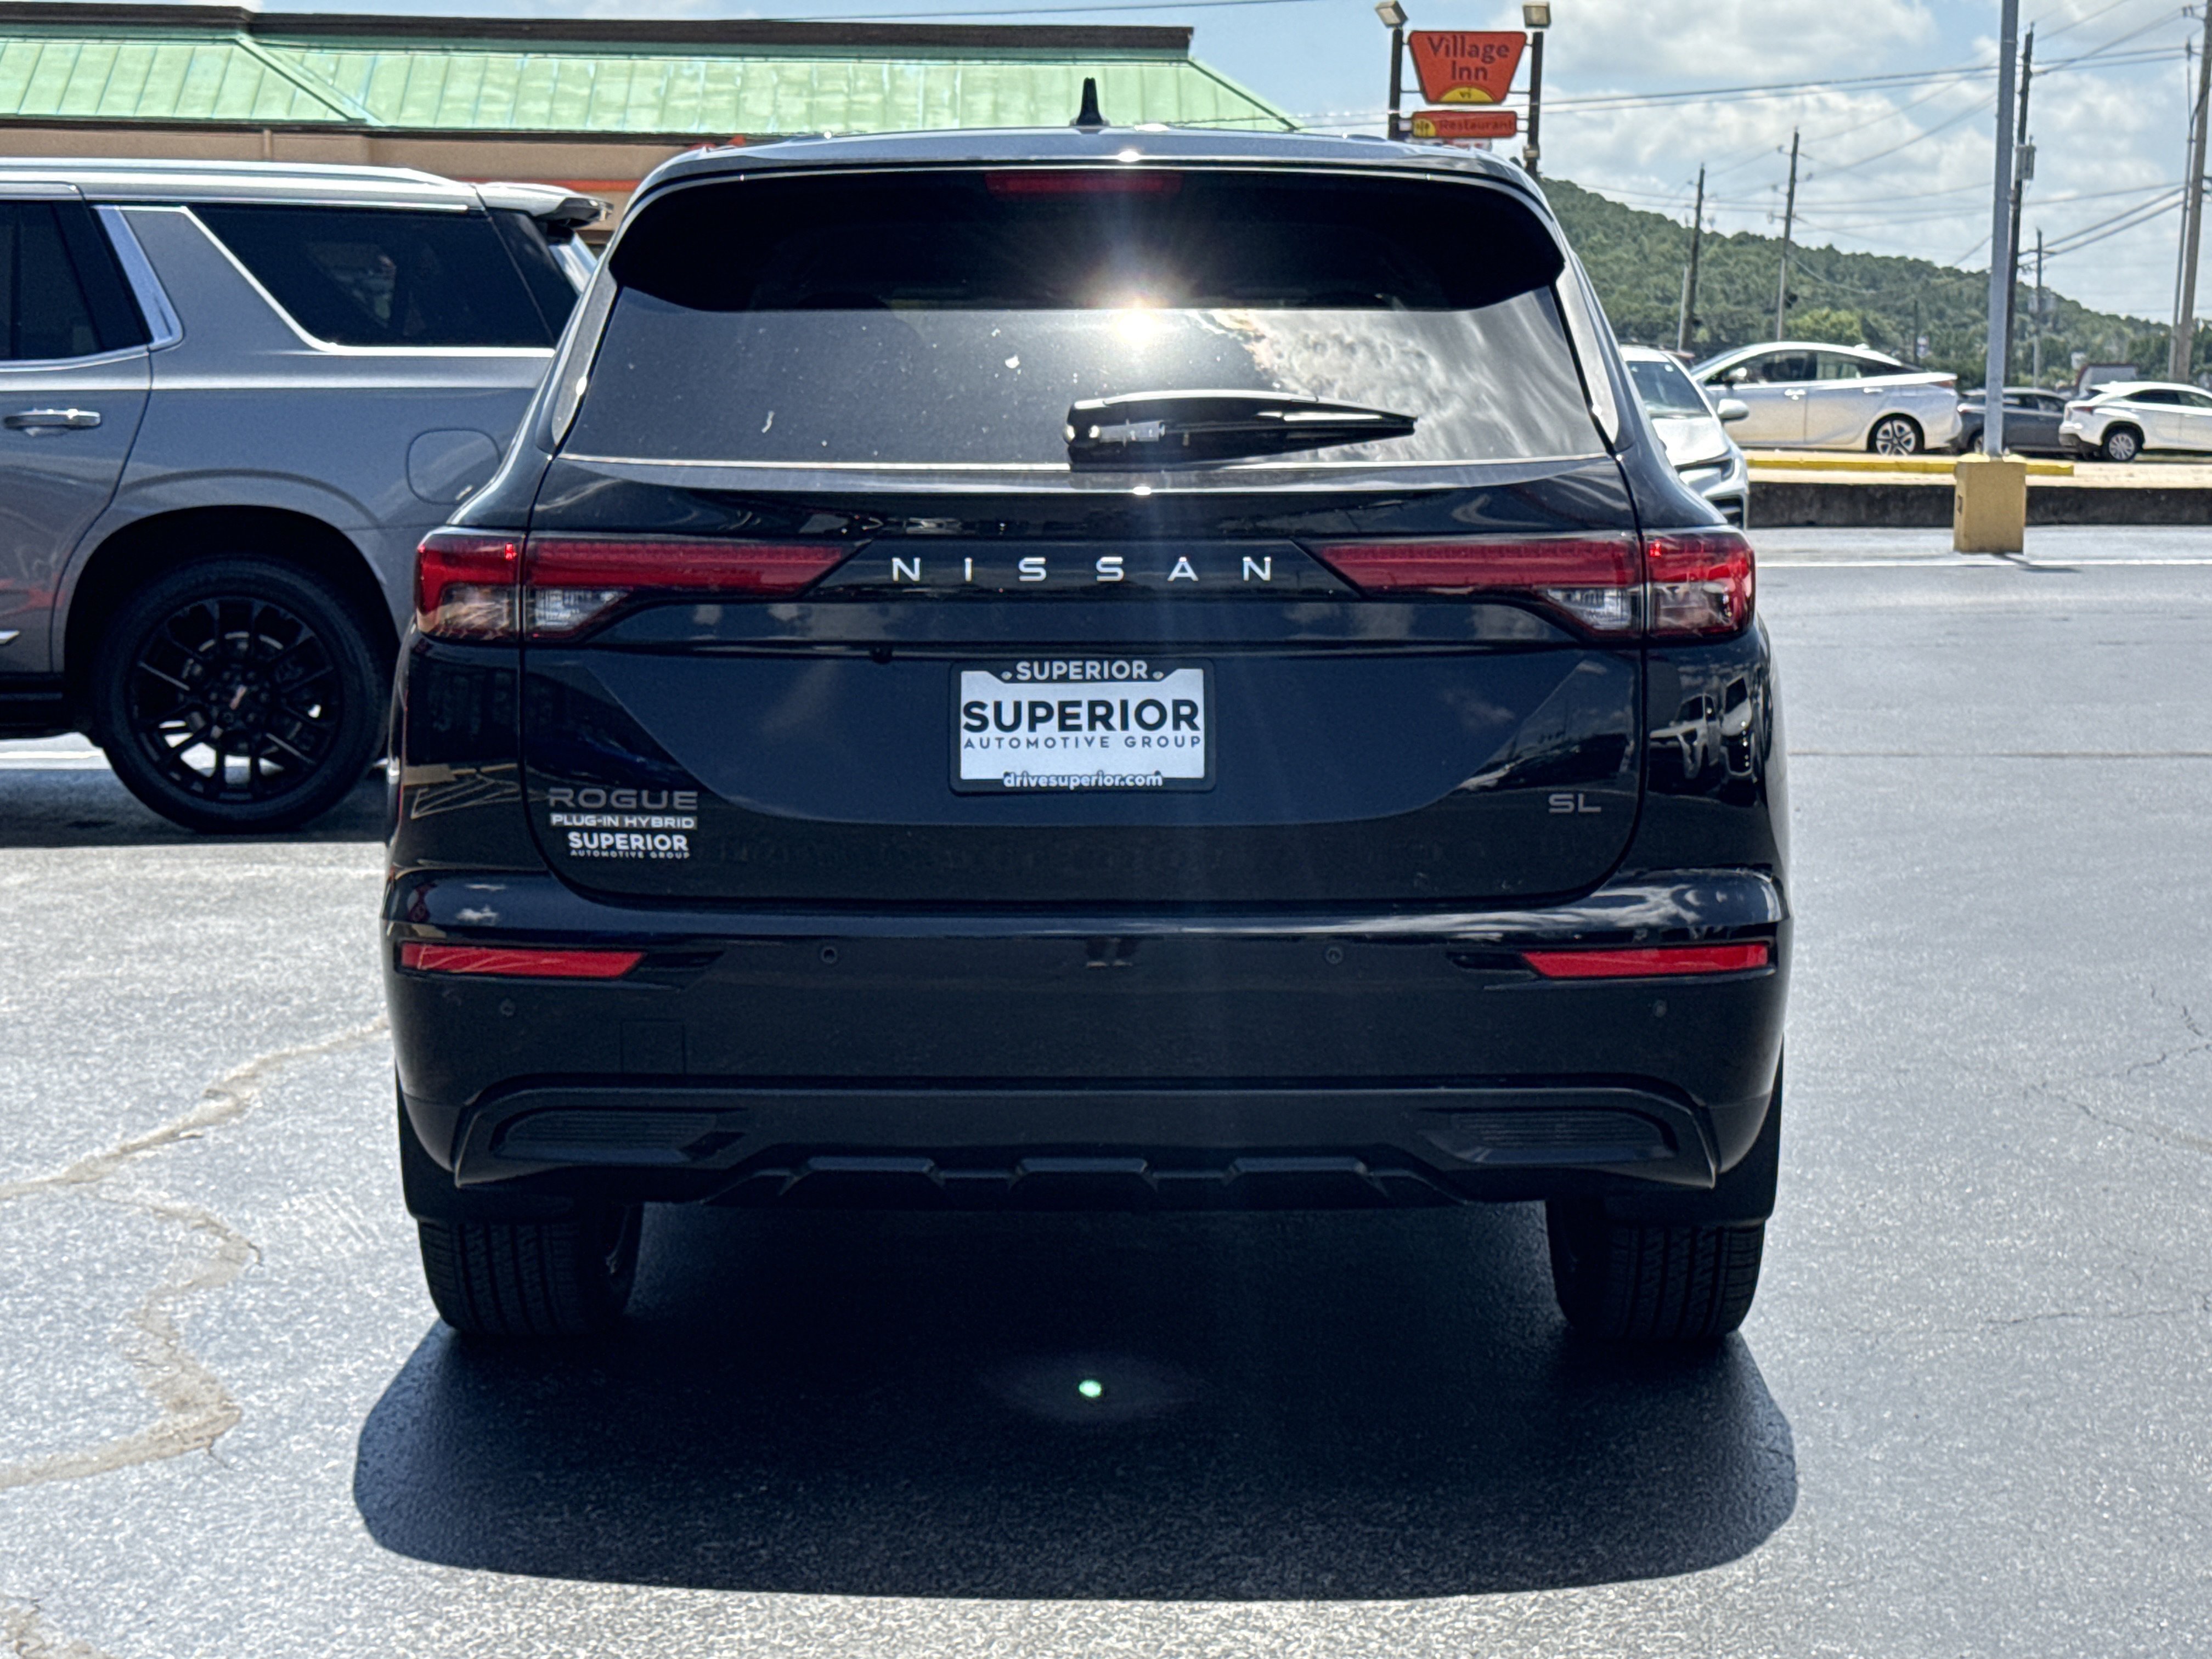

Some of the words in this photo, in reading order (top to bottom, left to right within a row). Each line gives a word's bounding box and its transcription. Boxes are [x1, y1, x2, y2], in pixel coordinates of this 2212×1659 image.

[1427, 35, 1510, 64] Village
[1452, 60, 1488, 81] Inn
[1439, 119, 1514, 131] Restaurant
[891, 557, 1272, 582] NISSAN
[1015, 660, 1148, 681] SUPERIOR
[962, 699, 1201, 733] SUPERIOR
[963, 736, 1111, 749] AUTOMOTIVE
[1124, 736, 1201, 748] GROUP
[1003, 770, 1164, 790] drivesuperior.com
[549, 788, 698, 810] ROGUE
[1548, 793, 1602, 814] SL
[551, 814, 620, 827] PLUG-IN
[624, 816, 695, 829] HYBRID
[568, 831, 689, 851] SUPERIOR
[570, 849, 645, 859] AUTOMOTIVE
